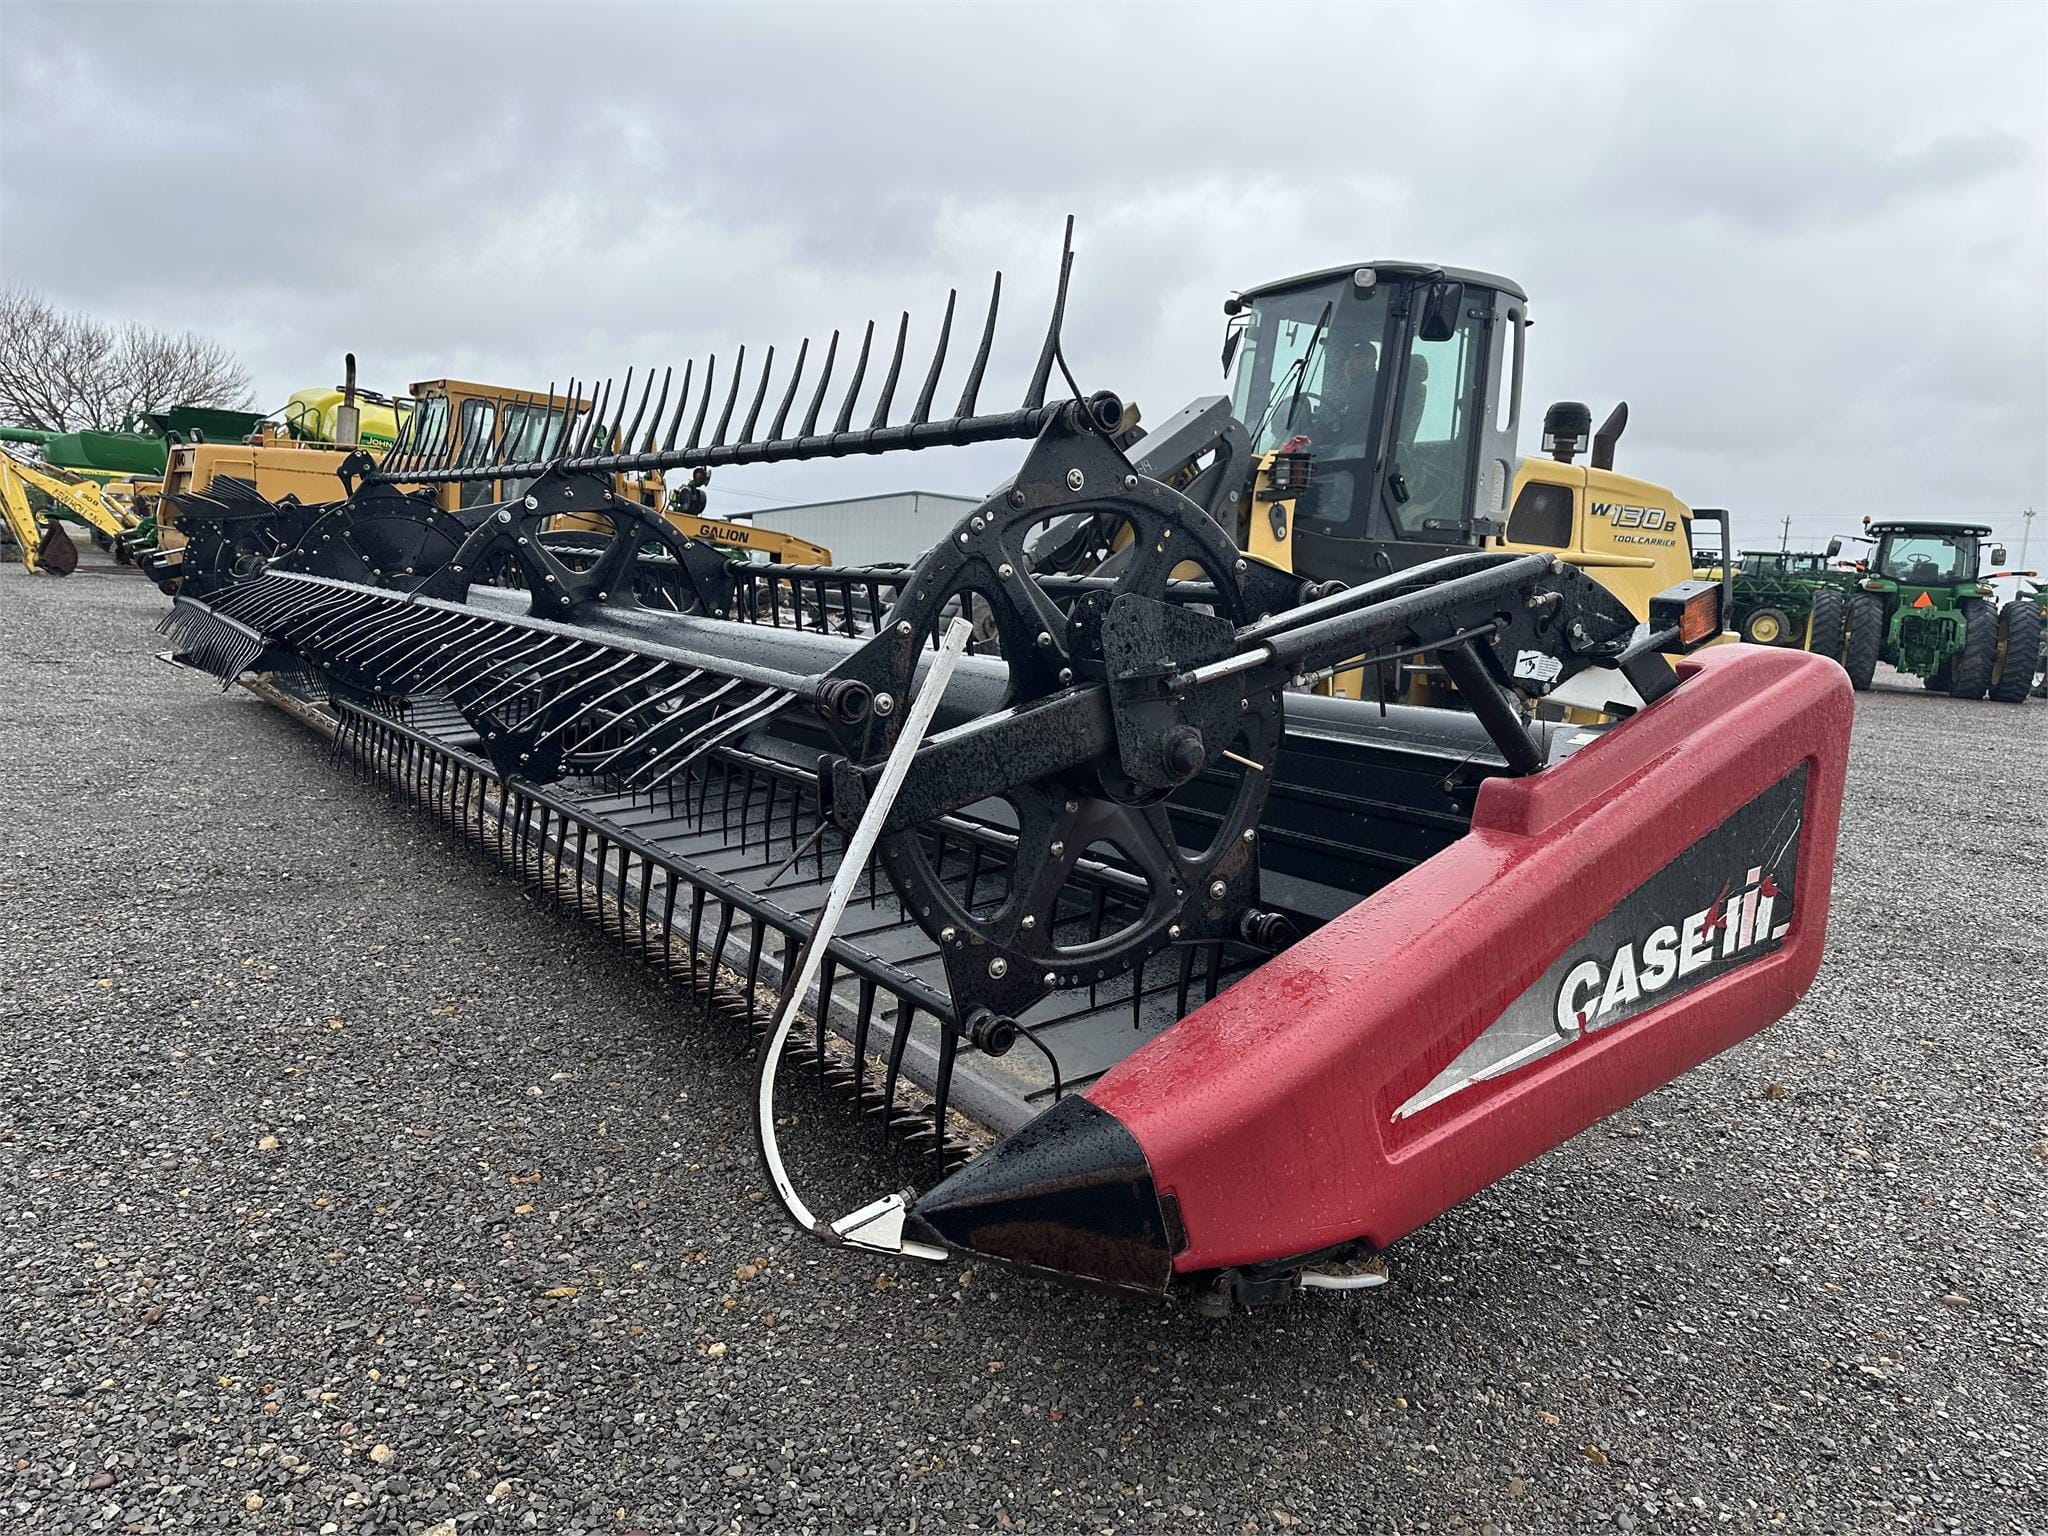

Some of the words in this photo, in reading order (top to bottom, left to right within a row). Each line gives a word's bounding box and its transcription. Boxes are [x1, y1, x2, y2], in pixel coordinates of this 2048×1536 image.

[366, 436, 393, 448] JOHN
[700, 524, 750, 544] GALION
[1612, 535, 1637, 544] TOOL
[1637, 536, 1677, 547] CARRIER
[1556, 907, 1716, 1031] CASE
